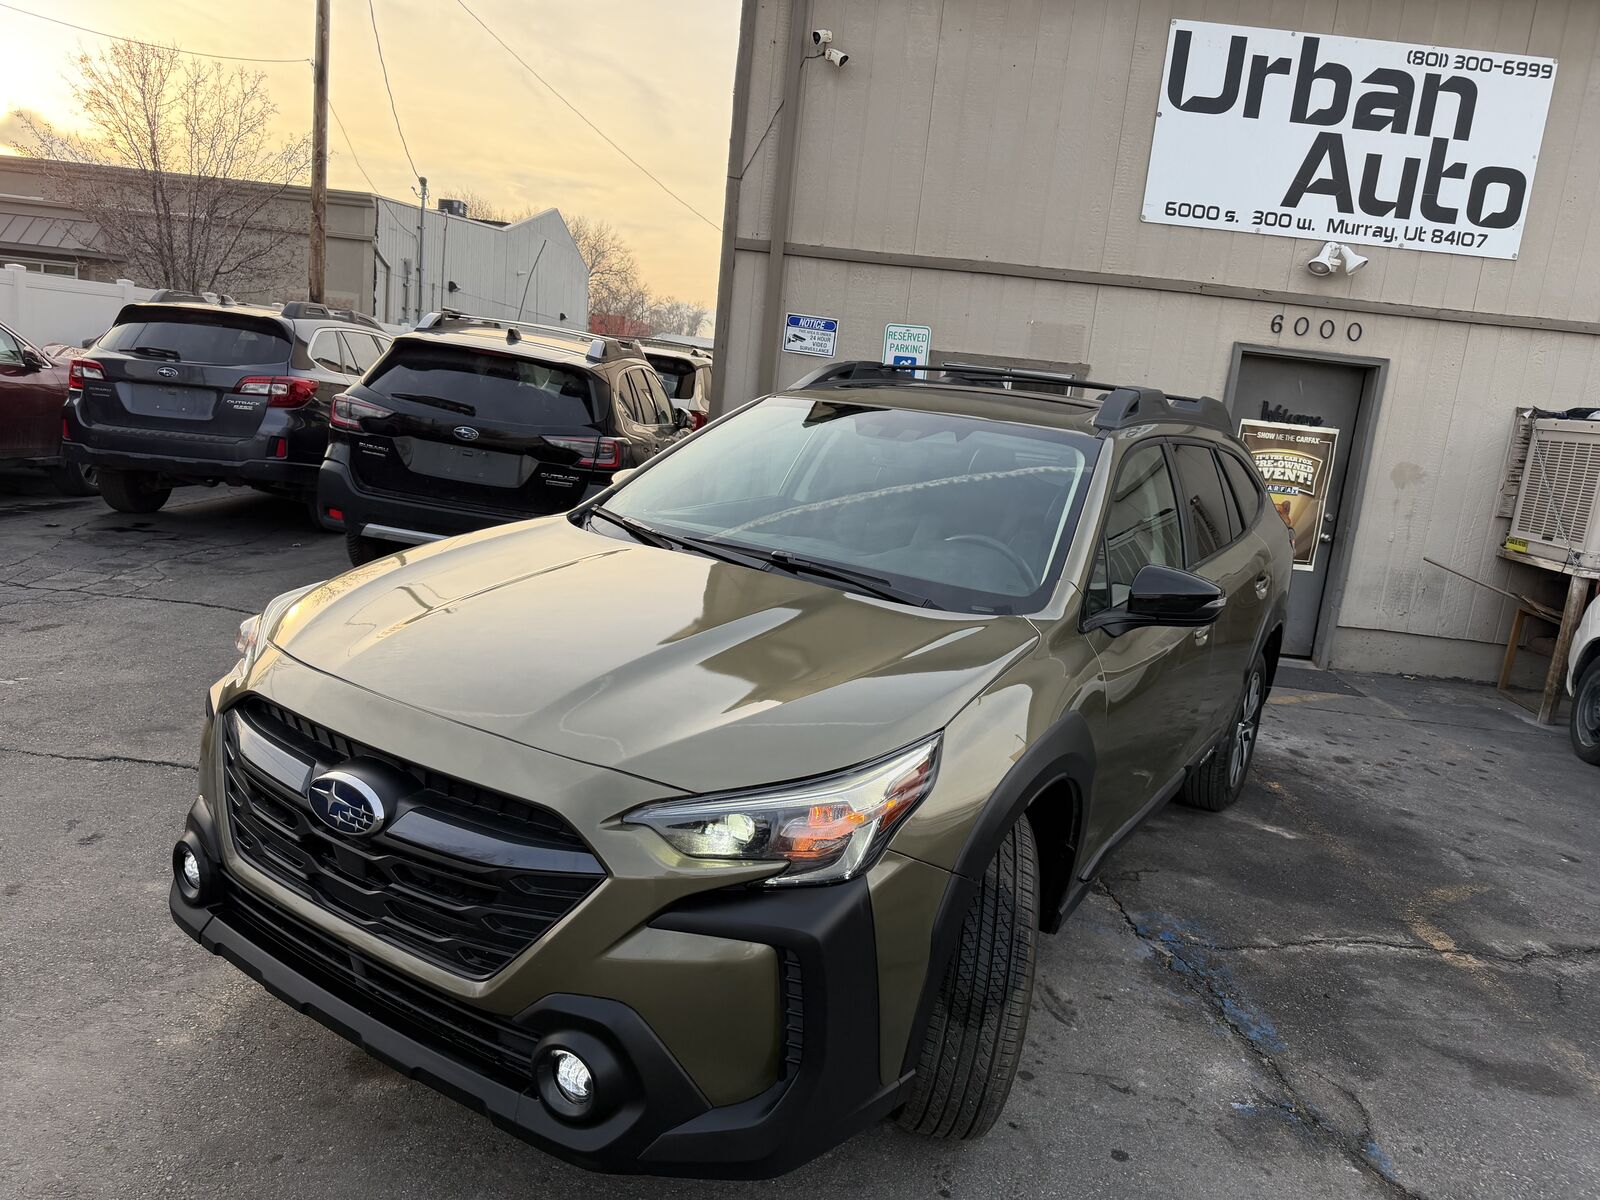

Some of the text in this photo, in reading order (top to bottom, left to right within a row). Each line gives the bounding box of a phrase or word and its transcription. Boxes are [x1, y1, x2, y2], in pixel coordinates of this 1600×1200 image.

[1407, 50, 1553, 79] (801) 300-6999
[1167, 29, 1478, 141] Urban
[1280, 131, 1527, 229] Auto
[1165, 201, 1220, 221] 6000
[1251, 210, 1292, 228] 300
[1326, 218, 1398, 243] Murray,
[1404, 225, 1427, 243] Ut
[1430, 228, 1488, 248] 84107
[799, 318, 826, 330] NOTICE
[1271, 314, 1362, 342] 6000
[888, 331, 927, 343] RESERVED
[889, 343, 923, 354] PARKING
[1296, 436, 1320, 444] CARFAX
[1299, 457, 1313, 466] FOX
[540, 472, 580, 482] OUTBACK
[1258, 467, 1313, 486] VENT!
[1265, 485, 1299, 494] ARFAX
